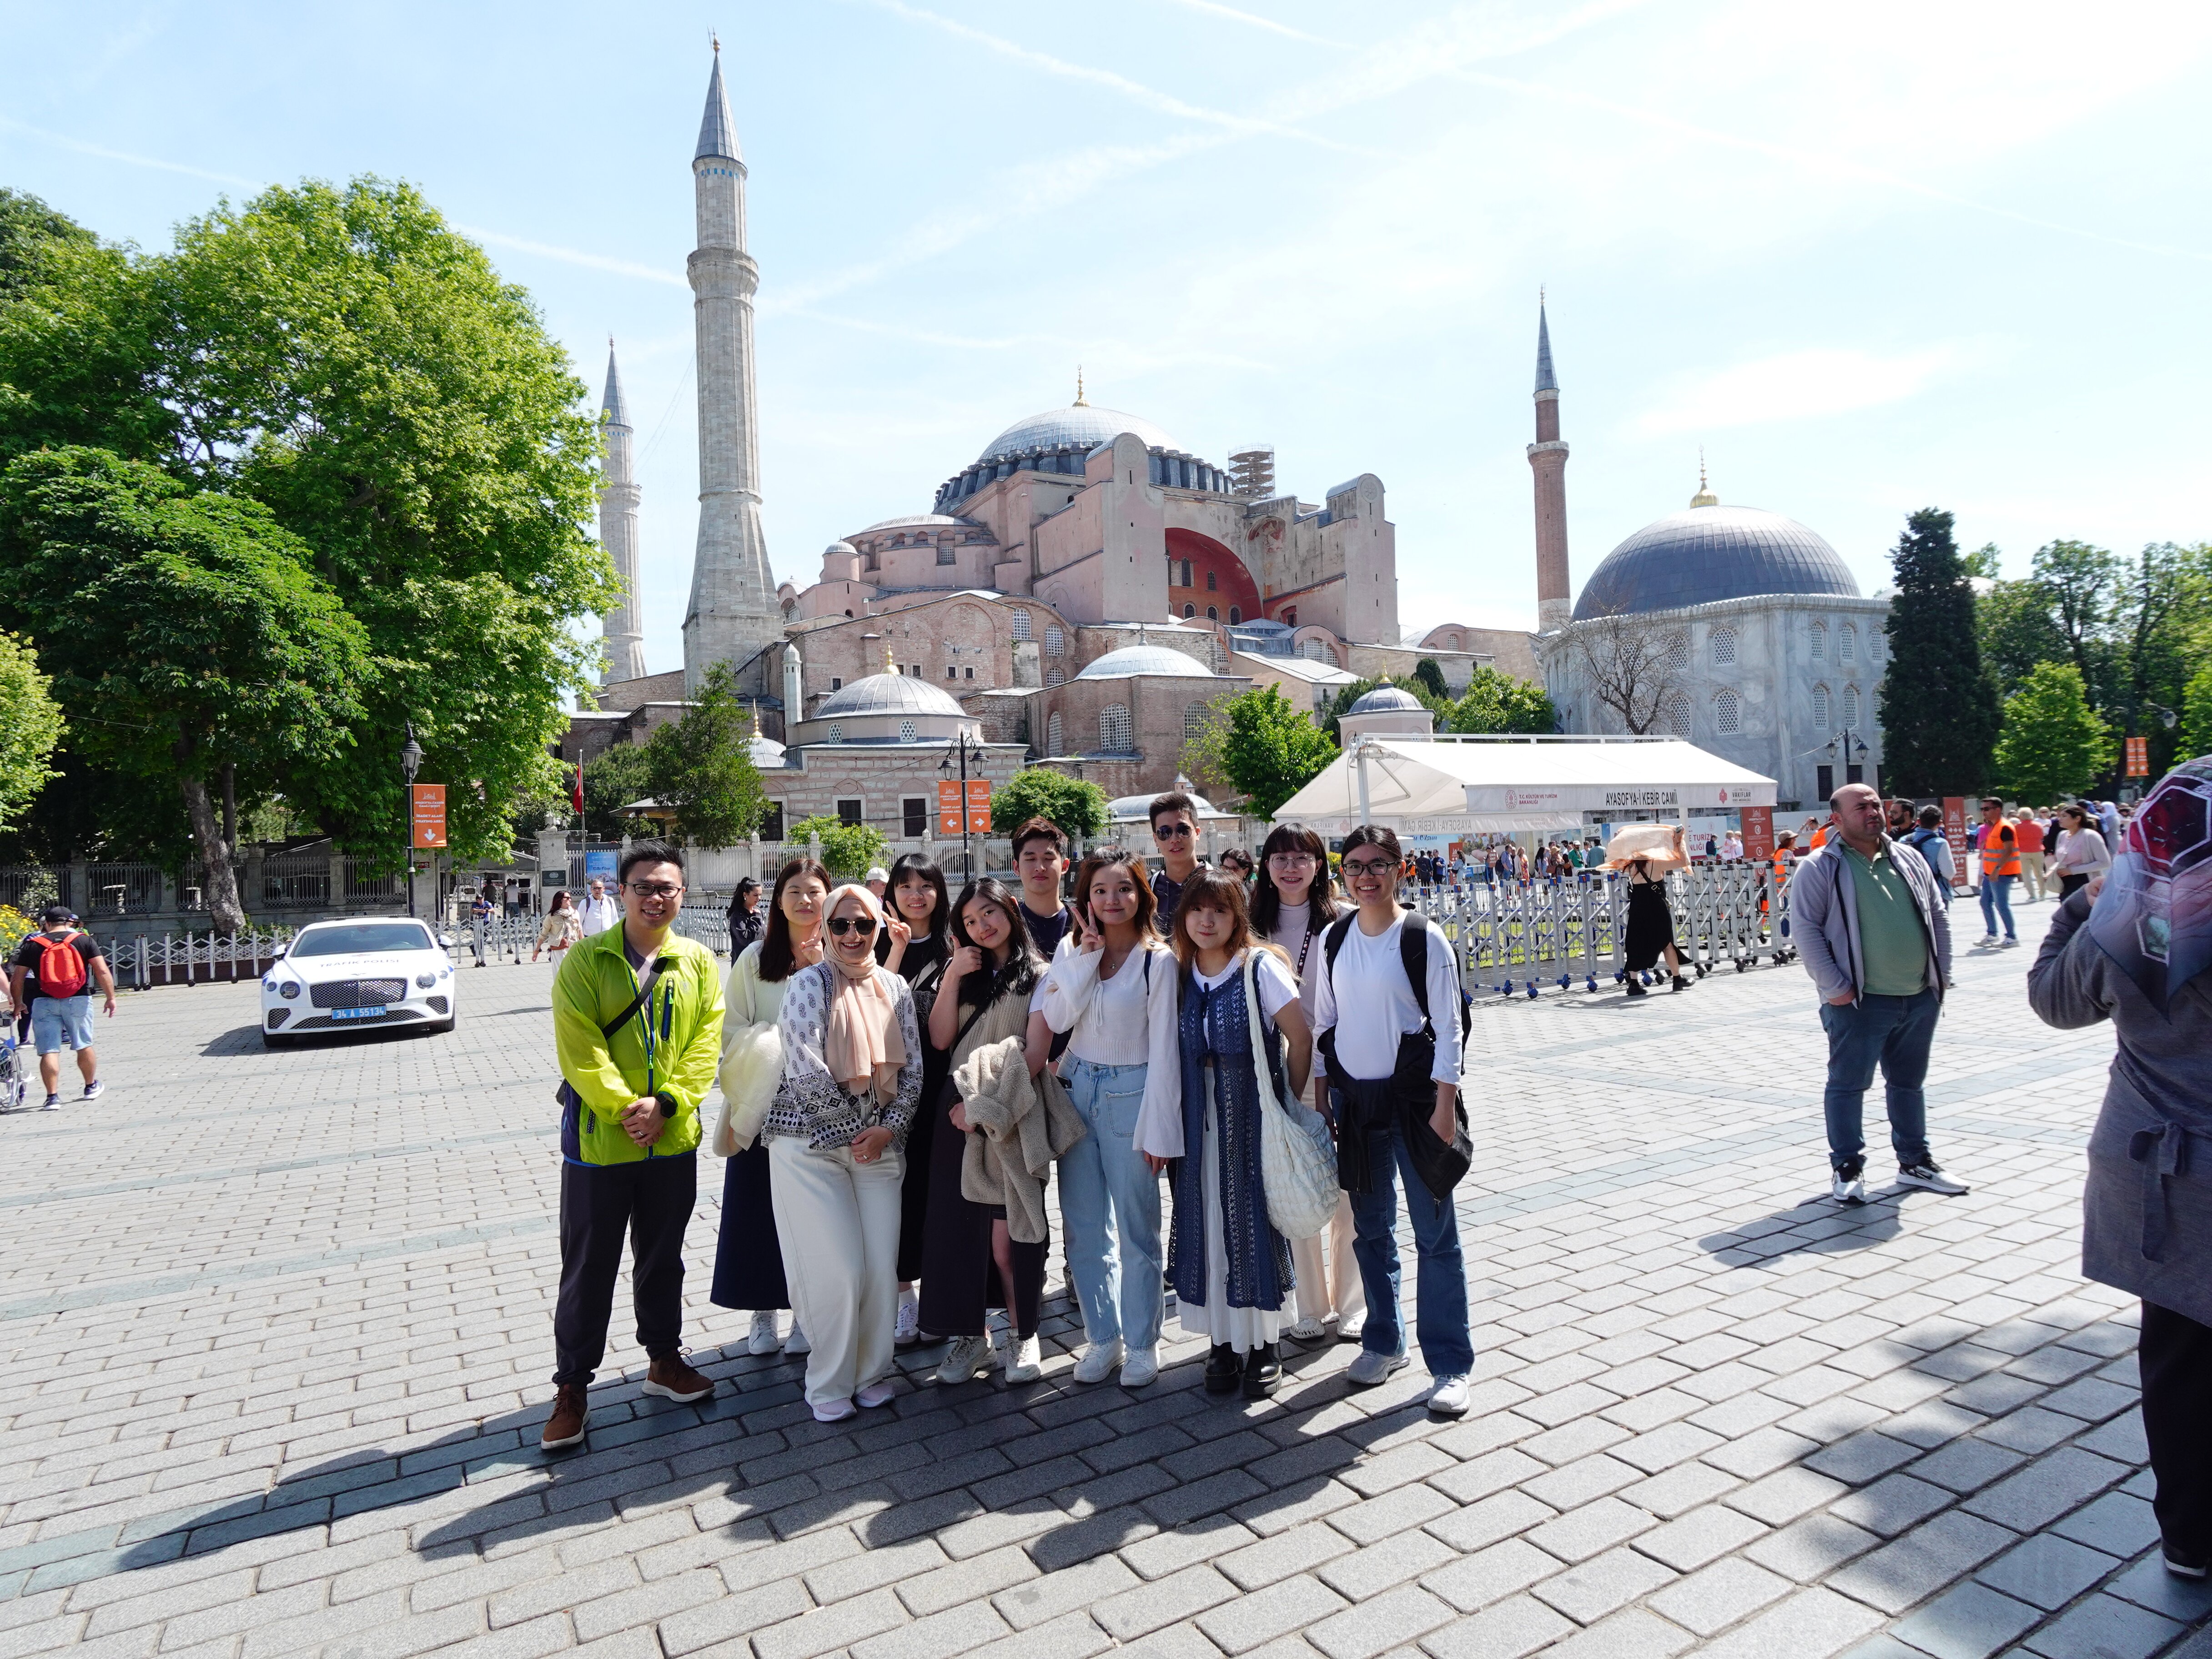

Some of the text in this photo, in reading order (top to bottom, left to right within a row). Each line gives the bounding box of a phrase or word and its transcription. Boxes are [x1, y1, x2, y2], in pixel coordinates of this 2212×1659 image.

[1606, 789, 1678, 806] AYASOFYA-İ KEBİR CAMİİ
[337, 1007, 384, 1018] 34 A 55134
